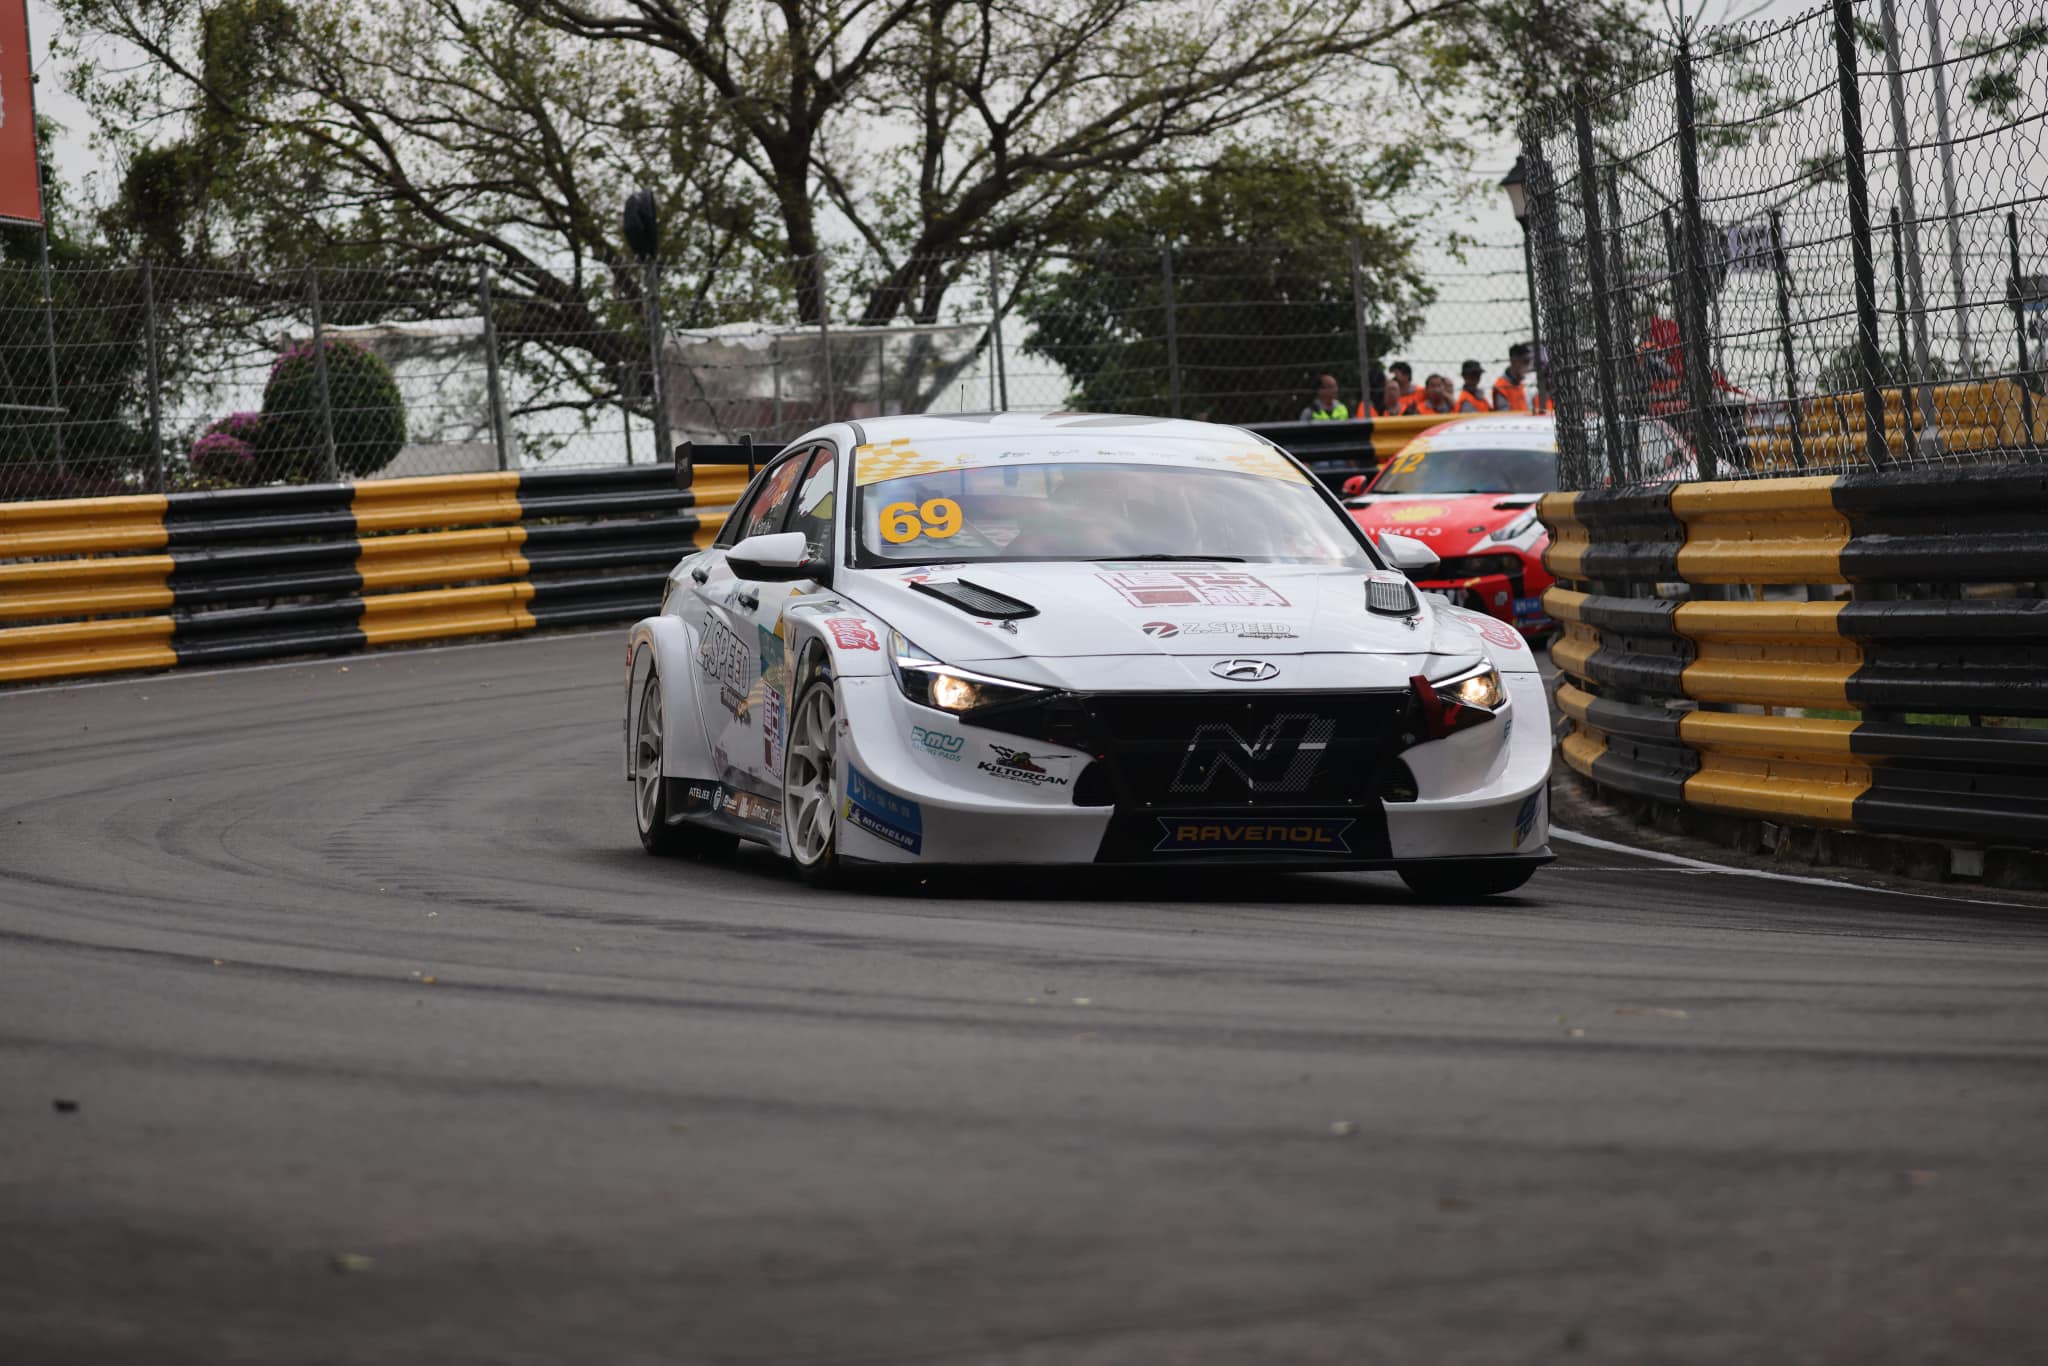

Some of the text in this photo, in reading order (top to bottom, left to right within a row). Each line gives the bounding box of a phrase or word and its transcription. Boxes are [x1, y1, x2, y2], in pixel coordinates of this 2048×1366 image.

[1391, 453, 1425, 475] 12
[880, 495, 963, 543] 69
[1183, 622, 1293, 635] Z.SPEED
[977, 761, 1068, 785] KILTORCAN
[688, 786, 710, 801] ATELIER
[862, 816, 914, 846] MICHELIN
[1176, 826, 1332, 842] RAVENOL
